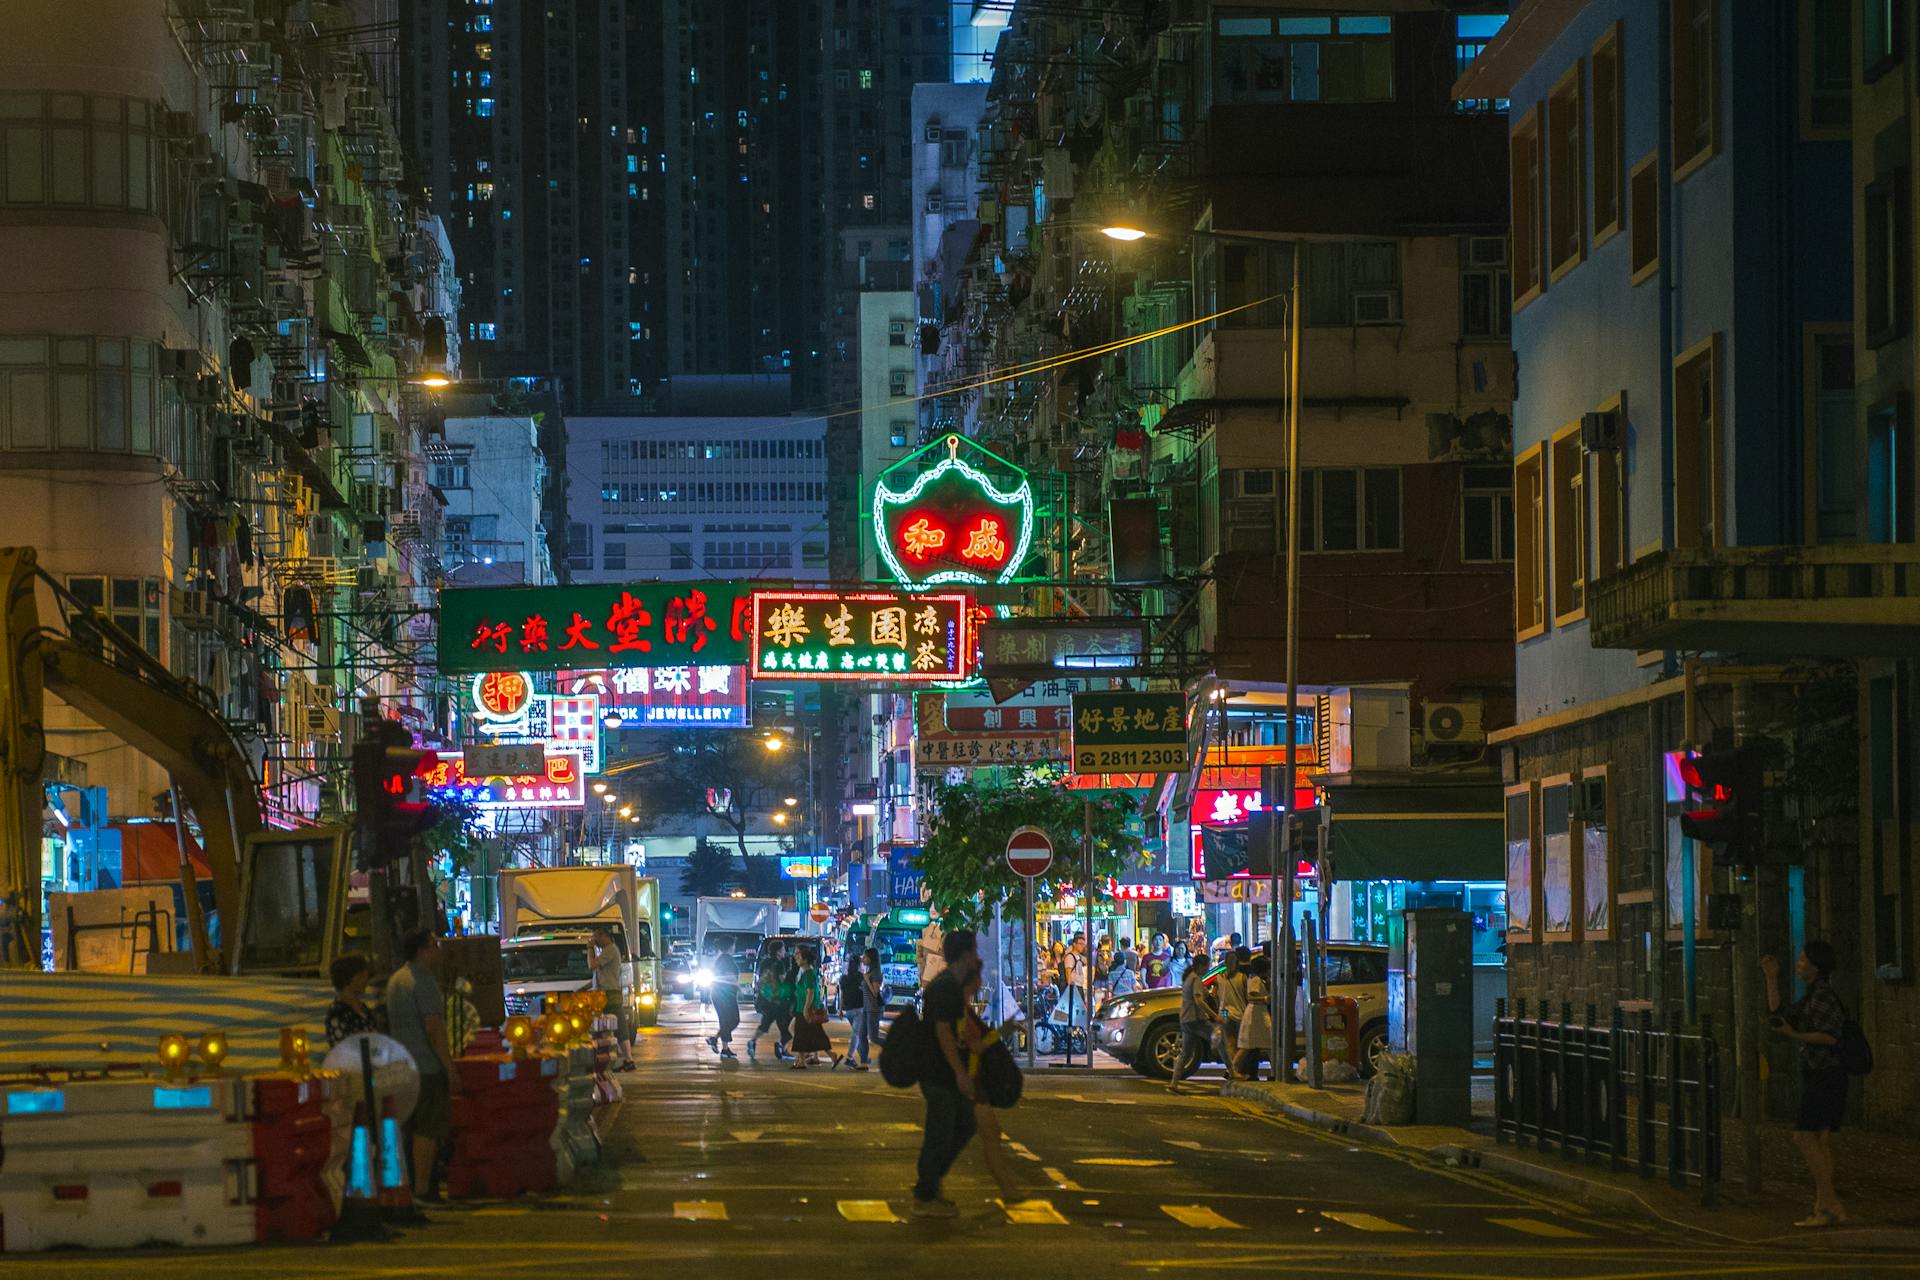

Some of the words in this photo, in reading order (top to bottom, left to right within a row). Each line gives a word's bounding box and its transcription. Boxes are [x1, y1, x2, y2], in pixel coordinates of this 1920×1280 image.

[764, 602, 907, 649] 樂生園
[647, 707, 732, 720] JEWELLERY
[1078, 706, 1183, 734] 好景地產
[1101, 751, 1137, 766] 2811
[1142, 749, 1184, 766] 2303
[895, 875, 924, 896] HAI
